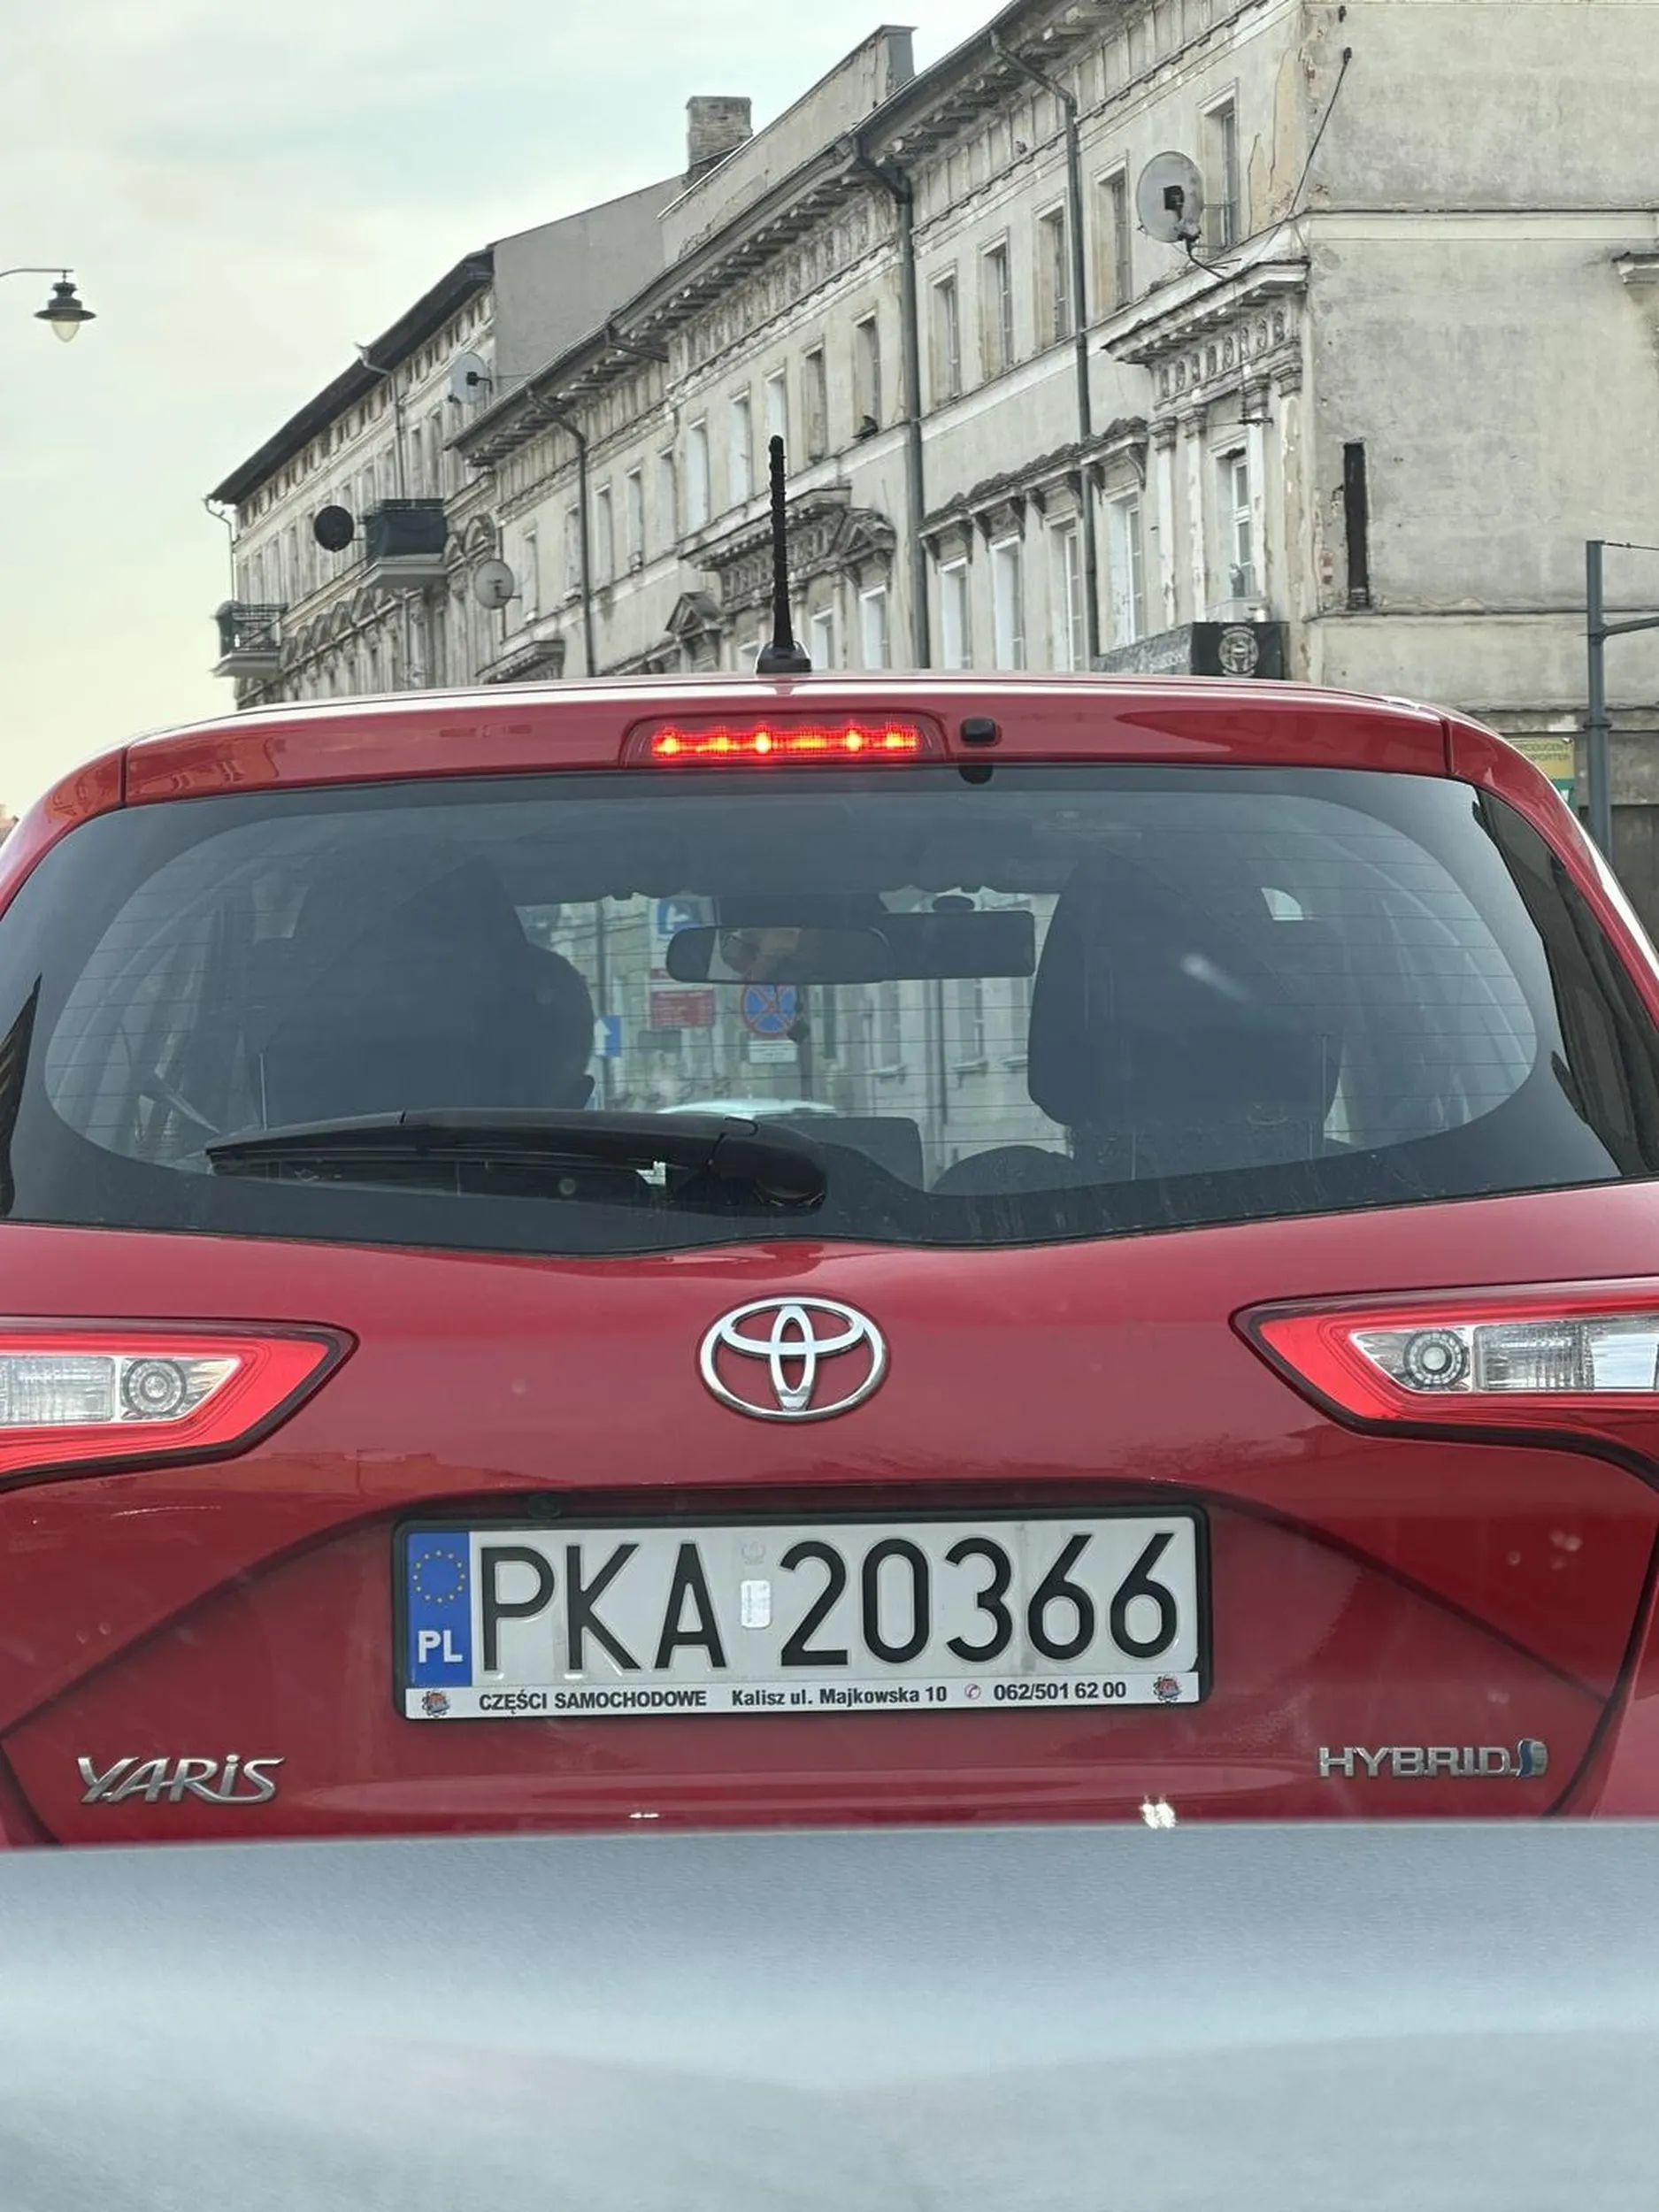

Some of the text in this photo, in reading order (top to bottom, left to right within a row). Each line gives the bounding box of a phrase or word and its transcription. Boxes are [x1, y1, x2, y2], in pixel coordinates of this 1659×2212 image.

[480, 1532, 1178, 1671] PKA 20366
[418, 1630, 464, 1664] PL
[479, 1681, 1127, 1715] CZĘŚCI SAMOCHODOWE Kalisz ul. Majkowska 10 062/501 62 00
[1318, 1747, 1512, 1778] HYBRID
